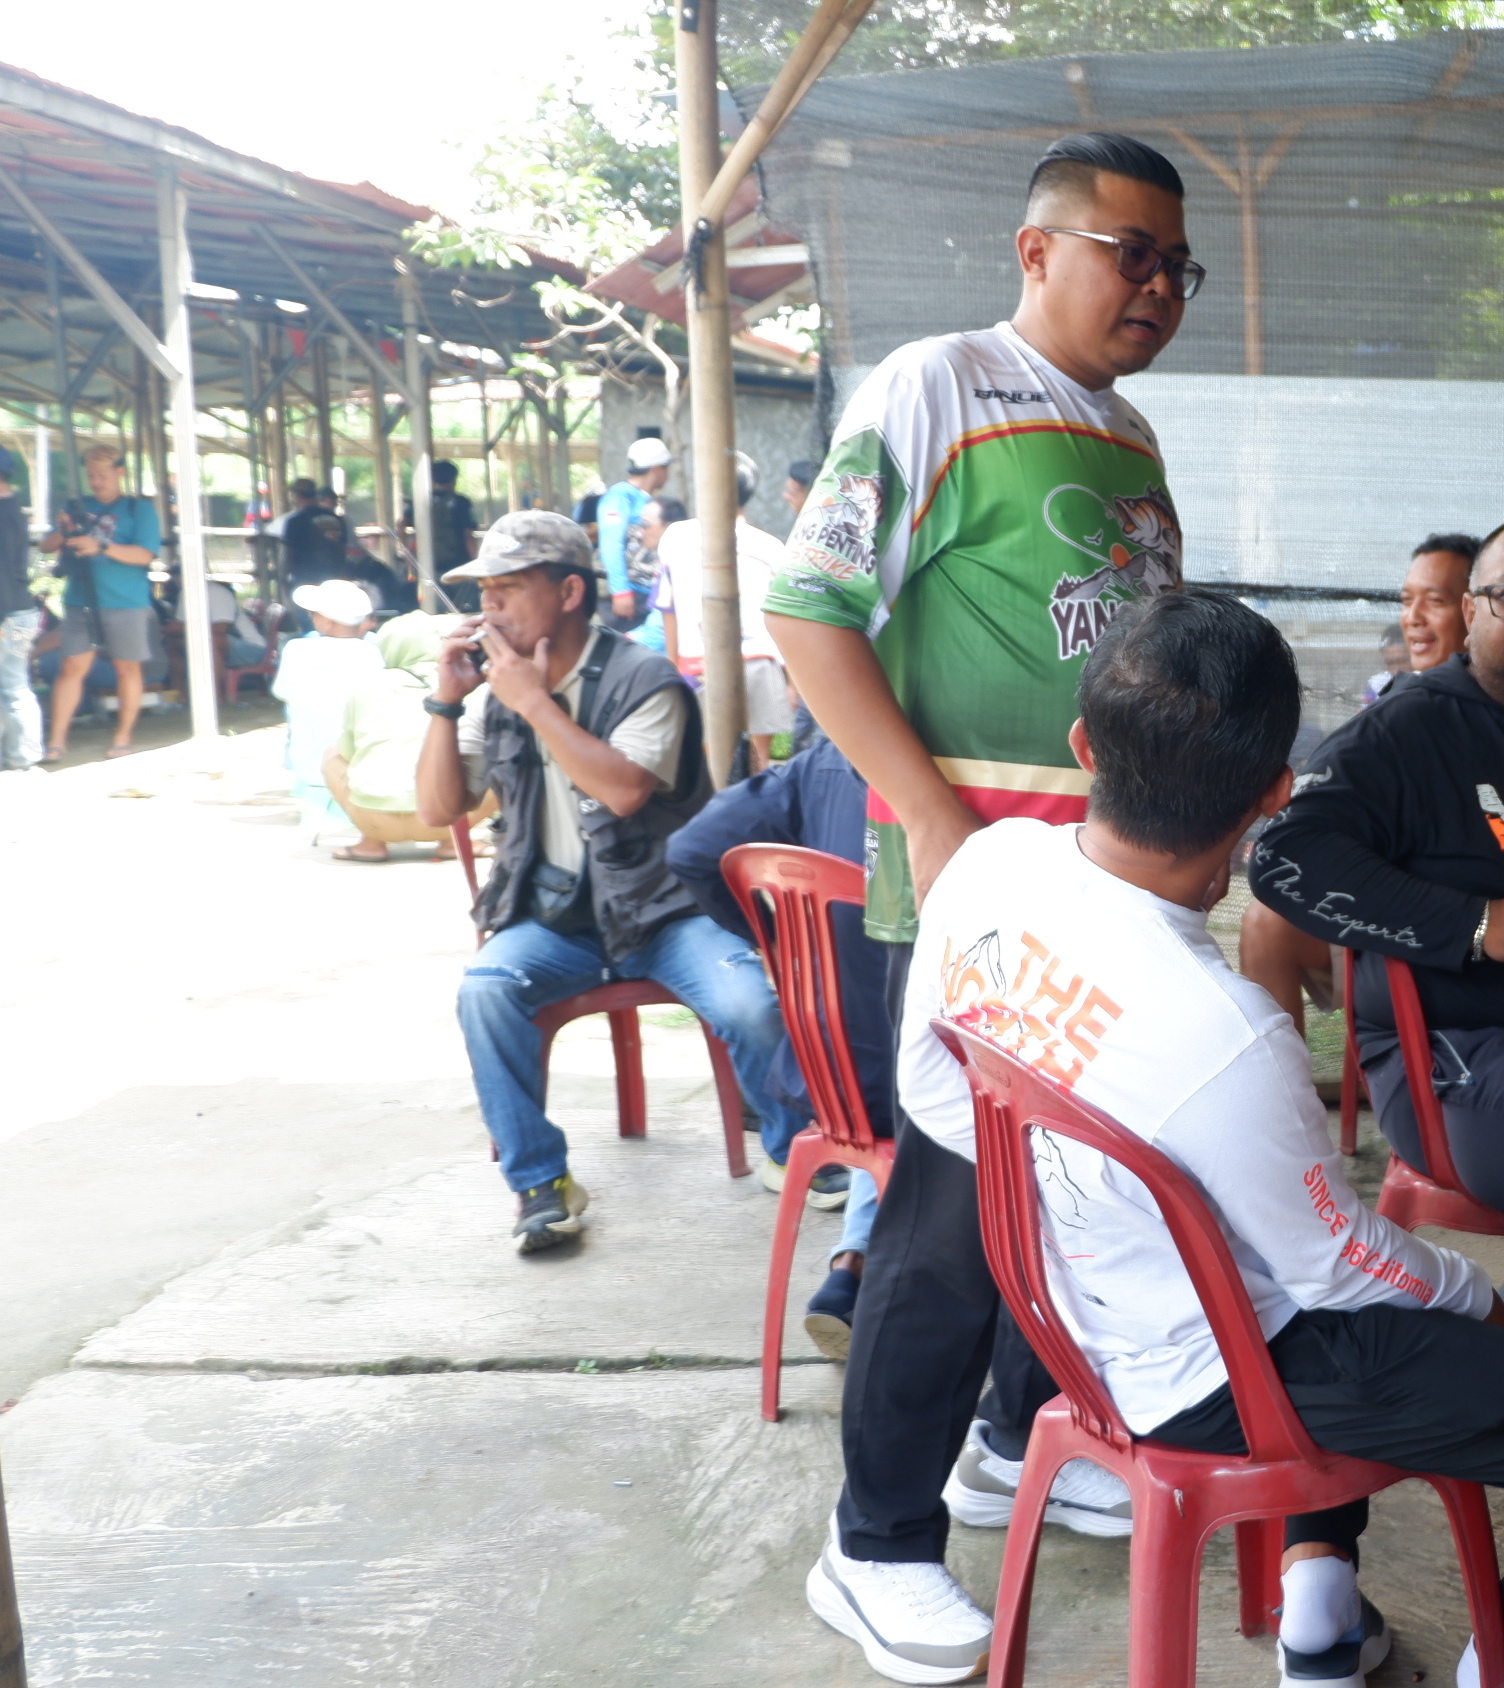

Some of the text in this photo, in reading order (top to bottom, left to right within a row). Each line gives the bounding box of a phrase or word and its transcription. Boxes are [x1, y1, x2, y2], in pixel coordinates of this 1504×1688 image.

[817, 525, 878, 576] PENTING
[1258, 856, 1305, 903] The
[1307, 891, 1424, 948] Experts
[1008, 930, 1124, 1062] THE
[1303, 1162, 1350, 1238] SINCE
[1361, 1252, 1435, 1305] California
